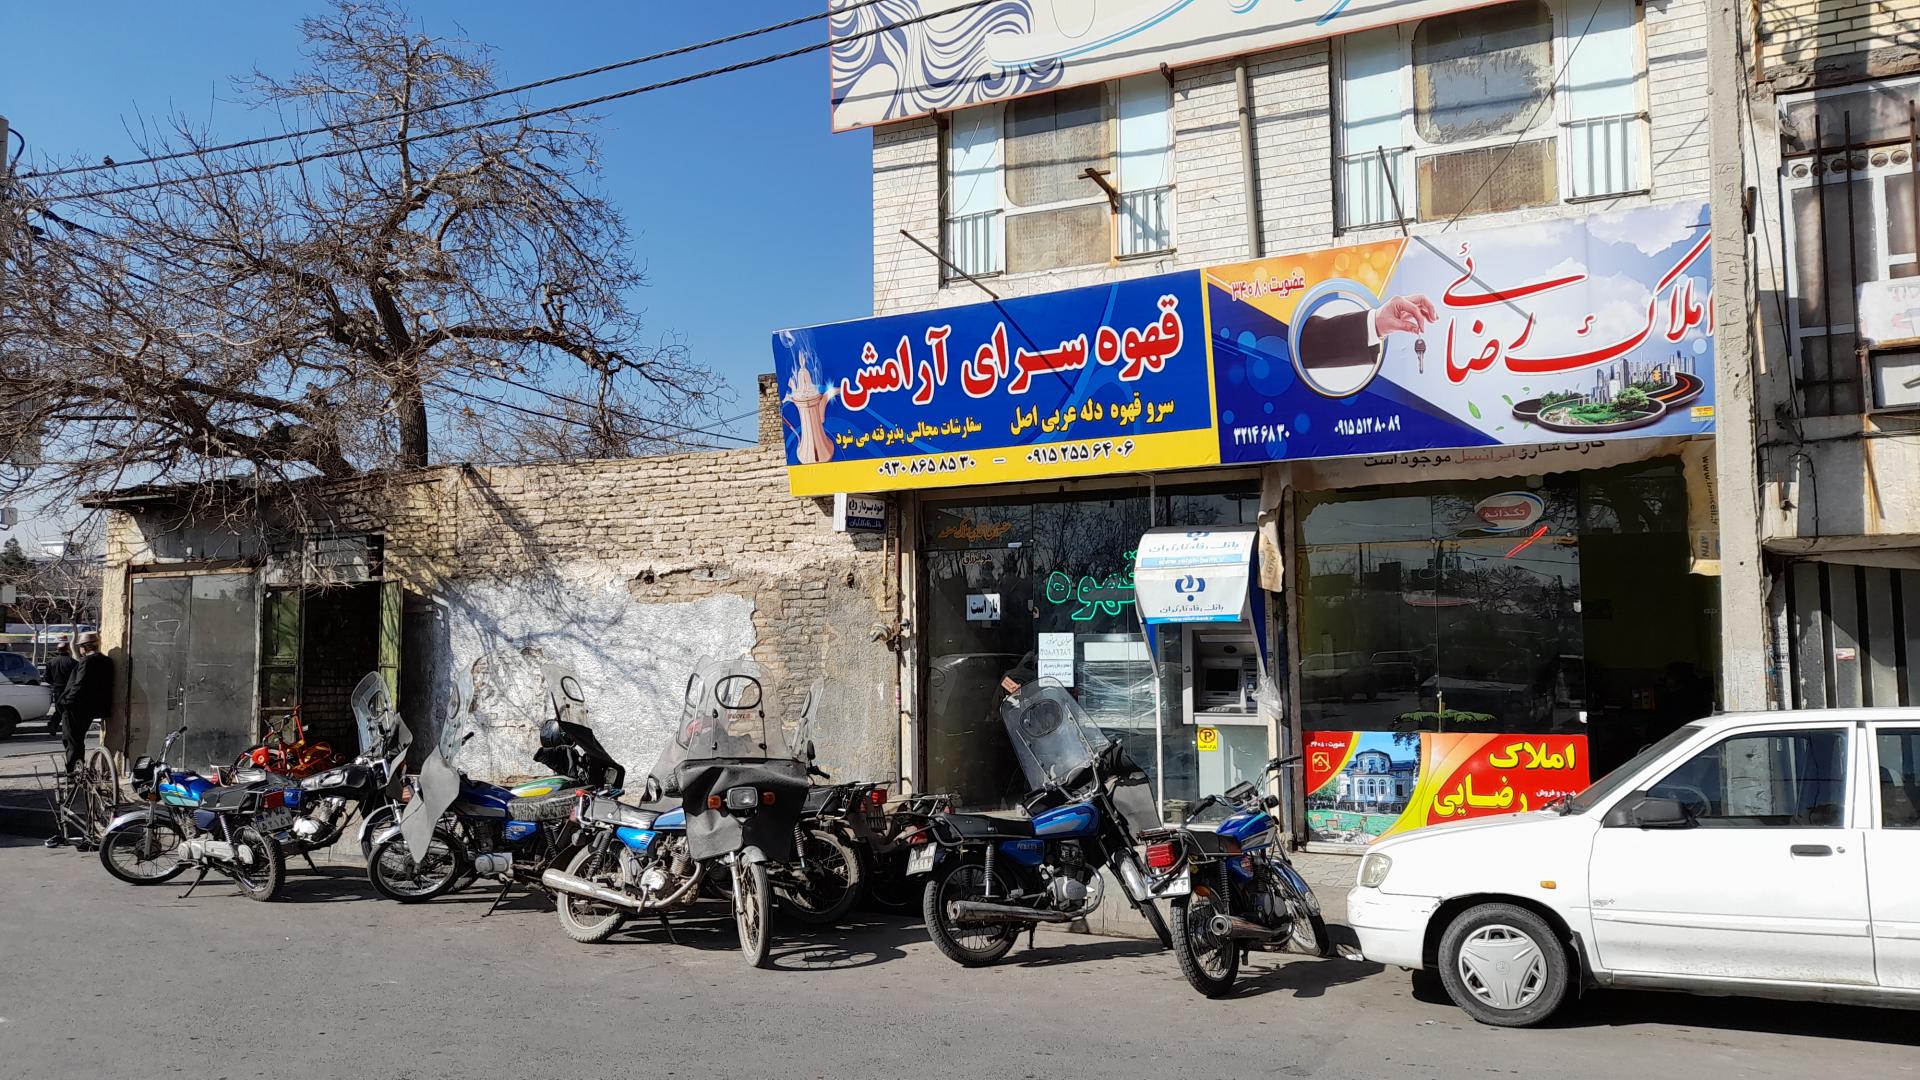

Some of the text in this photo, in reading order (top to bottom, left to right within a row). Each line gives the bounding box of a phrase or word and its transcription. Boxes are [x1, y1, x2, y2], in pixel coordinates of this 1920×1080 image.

[1231, 280, 1262, 301] ۳۴۰۸
[841, 293, 1184, 410] قهوه سرای آرامش
[1010, 391, 1175, 435] سرو قهوه دله عربی اصل
[835, 416, 982, 449] سفارشات مجالس پذیرفته می شود
[1364, 454, 1398, 467] است
[1400, 450, 1451, 467] موجود
[1454, 447, 1516, 464] ایرانسیل
[970, 599, 987, 615] است
[1489, 741, 1576, 770] املاک
[1433, 772, 1528, 817] رضایی
